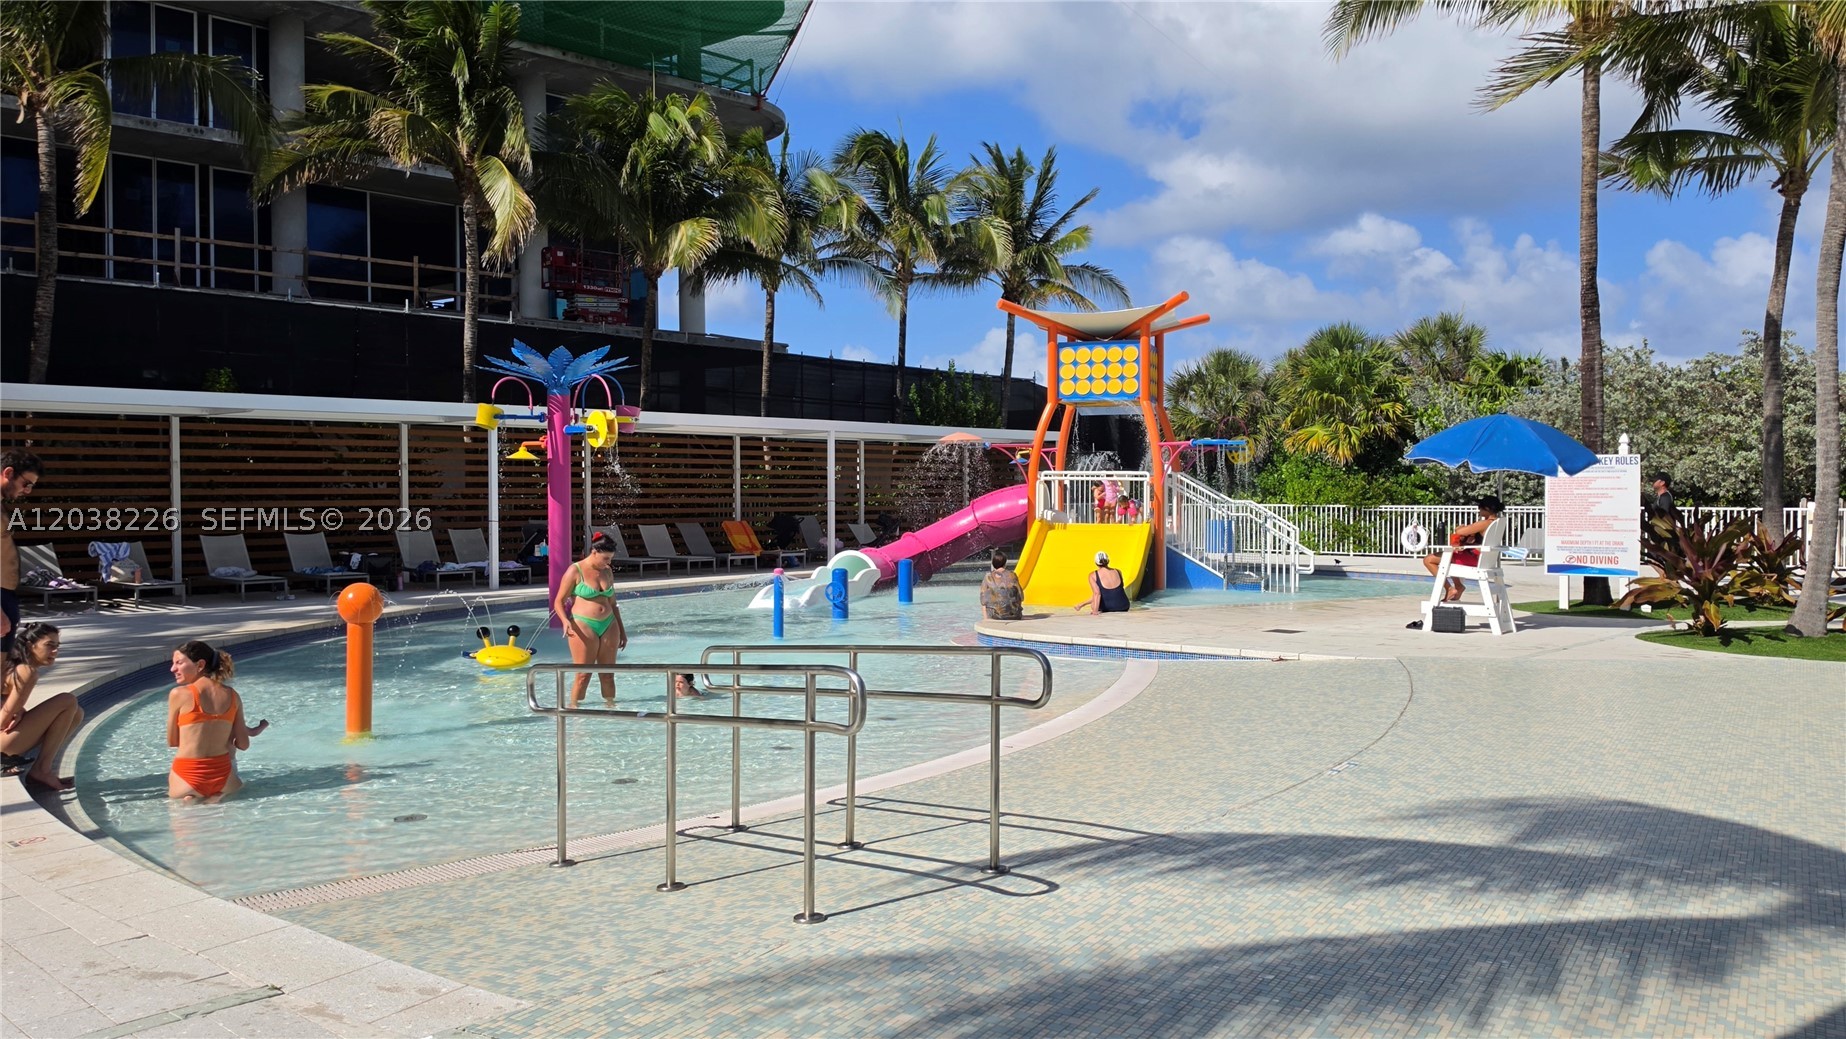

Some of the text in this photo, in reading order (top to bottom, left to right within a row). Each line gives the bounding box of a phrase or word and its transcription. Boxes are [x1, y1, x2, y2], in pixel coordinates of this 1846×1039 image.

[1615, 456, 1638, 465] RULES
[1576, 555, 1619, 565] NO DIVING
